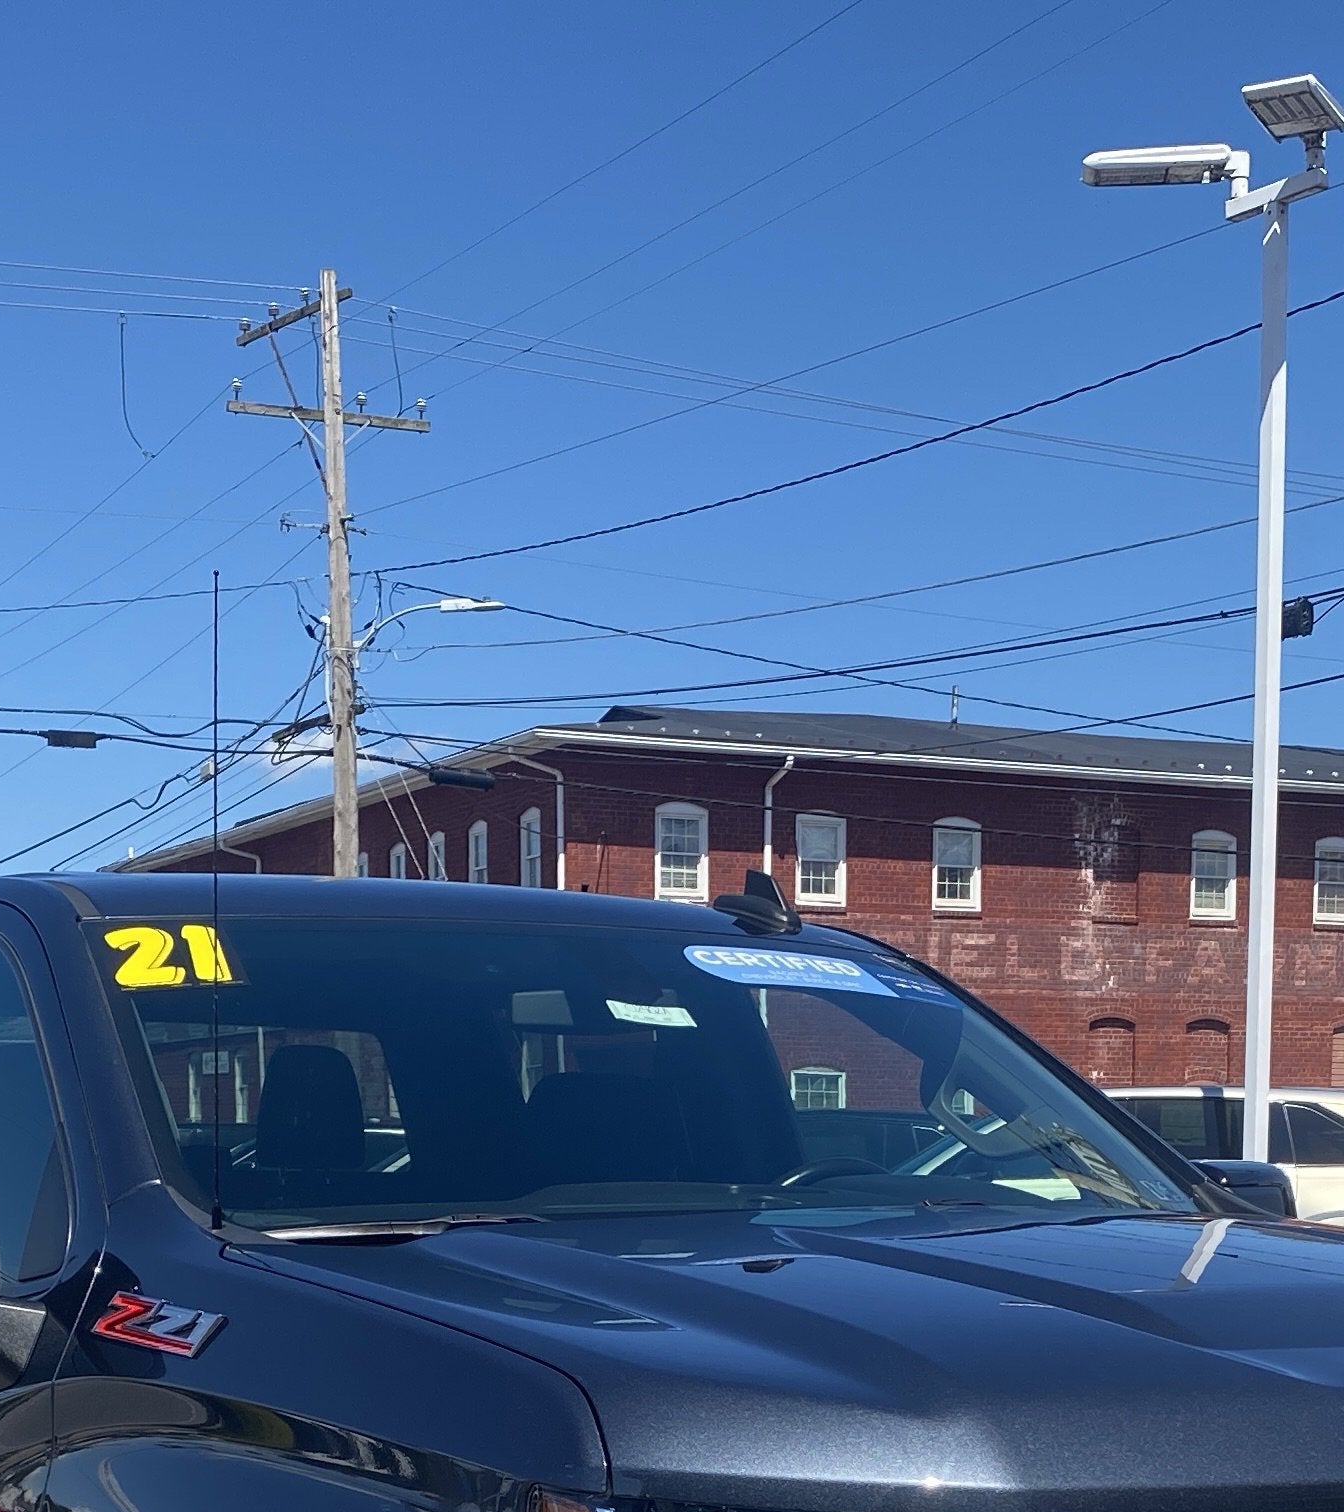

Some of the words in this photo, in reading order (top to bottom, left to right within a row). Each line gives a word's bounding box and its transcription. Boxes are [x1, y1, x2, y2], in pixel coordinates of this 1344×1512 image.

[104, 925, 232, 987] 21
[692, 949, 862, 977] CERTIFIED
[91, 1290, 227, 1358] Z71
